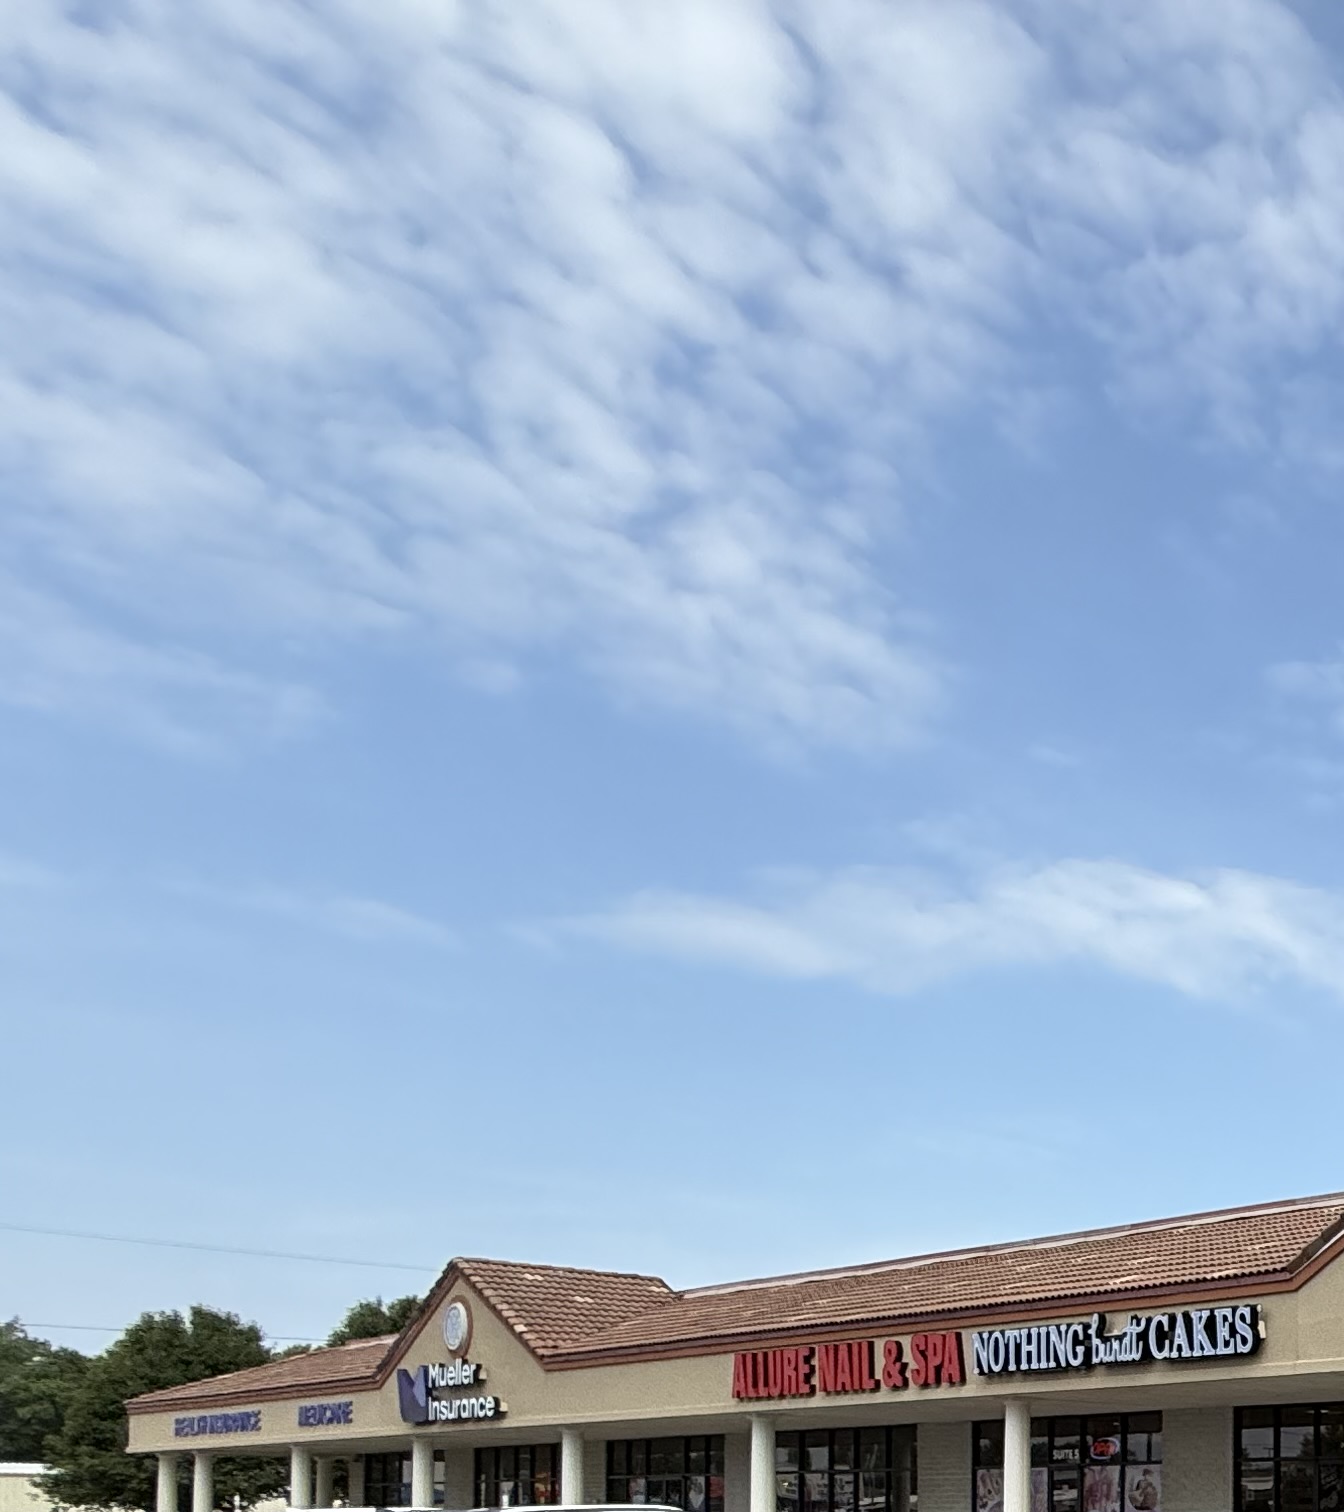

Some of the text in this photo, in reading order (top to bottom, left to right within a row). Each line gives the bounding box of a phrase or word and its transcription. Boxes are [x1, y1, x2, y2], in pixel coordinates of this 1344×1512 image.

[972, 1323, 1085, 1375] NOTHING
[1150, 1306, 1253, 1359] CAKES
[428, 1358, 477, 1388] Mueller
[732, 1332, 962, 1399] ALLURE NAIL & SPA
[428, 1396, 496, 1421] Insurance
